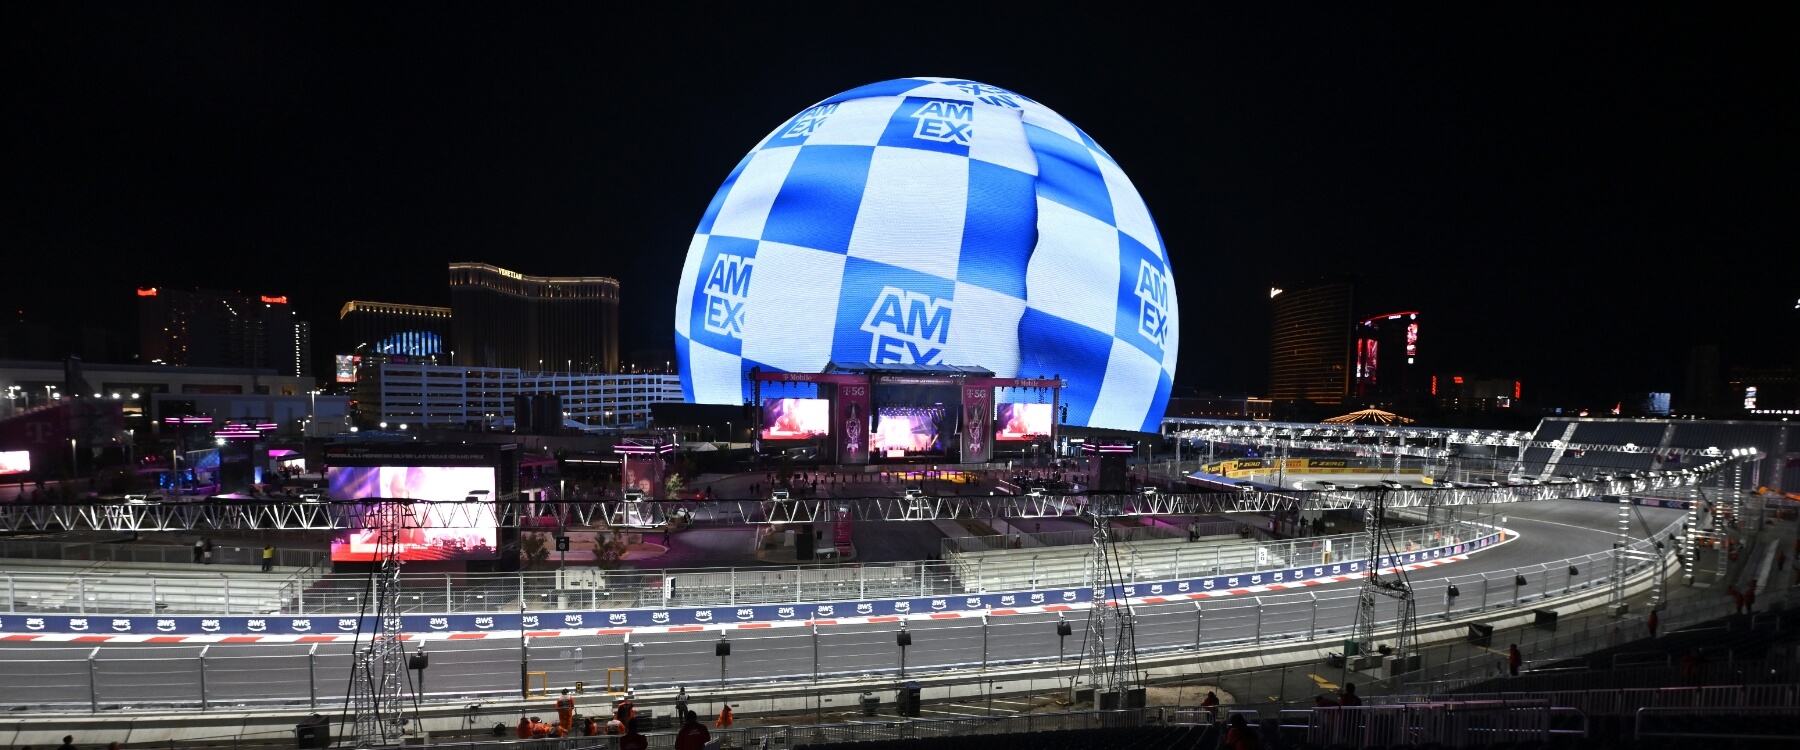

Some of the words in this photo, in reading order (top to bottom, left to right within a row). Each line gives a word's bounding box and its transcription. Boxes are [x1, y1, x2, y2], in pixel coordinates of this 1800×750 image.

[806, 102, 841, 117] AM
[919, 102, 973, 121] AM
[788, 117, 822, 134] EX
[919, 119, 972, 141] EX
[708, 260, 753, 297] AM
[1140, 266, 1168, 312] AM
[708, 296, 745, 333] EX
[870, 294, 952, 344] AM
[1143, 300, 1167, 345] EX
[876, 334, 942, 364] EX
[790, 373, 811, 381] Mobile
[851, 386, 865, 395] 5G
[974, 389, 986, 398] 5G
[895, 601, 908, 609] aws
[932, 599, 945, 607] aws
[967, 597, 980, 605] aws
[778, 607, 793, 615] aws
[818, 605, 833, 613] aws
[857, 603, 871, 611] aws
[652, 612, 669, 621] aws
[695, 610, 711, 619] aws
[737, 608, 753, 616] aws
[475, 617, 493, 626] aws
[523, 616, 538, 625] aws
[565, 615, 582, 624] aws
[609, 613, 626, 622] aws
[26, 618, 43, 627] aws
[70, 619, 87, 628] aws
[113, 619, 130, 628] aws
[157, 619, 175, 628] aws
[201, 619, 219, 628] aws
[247, 619, 265, 628] aws
[292, 619, 310, 628] aws
[339, 619, 356, 628] aws
[430, 618, 447, 627] aws
